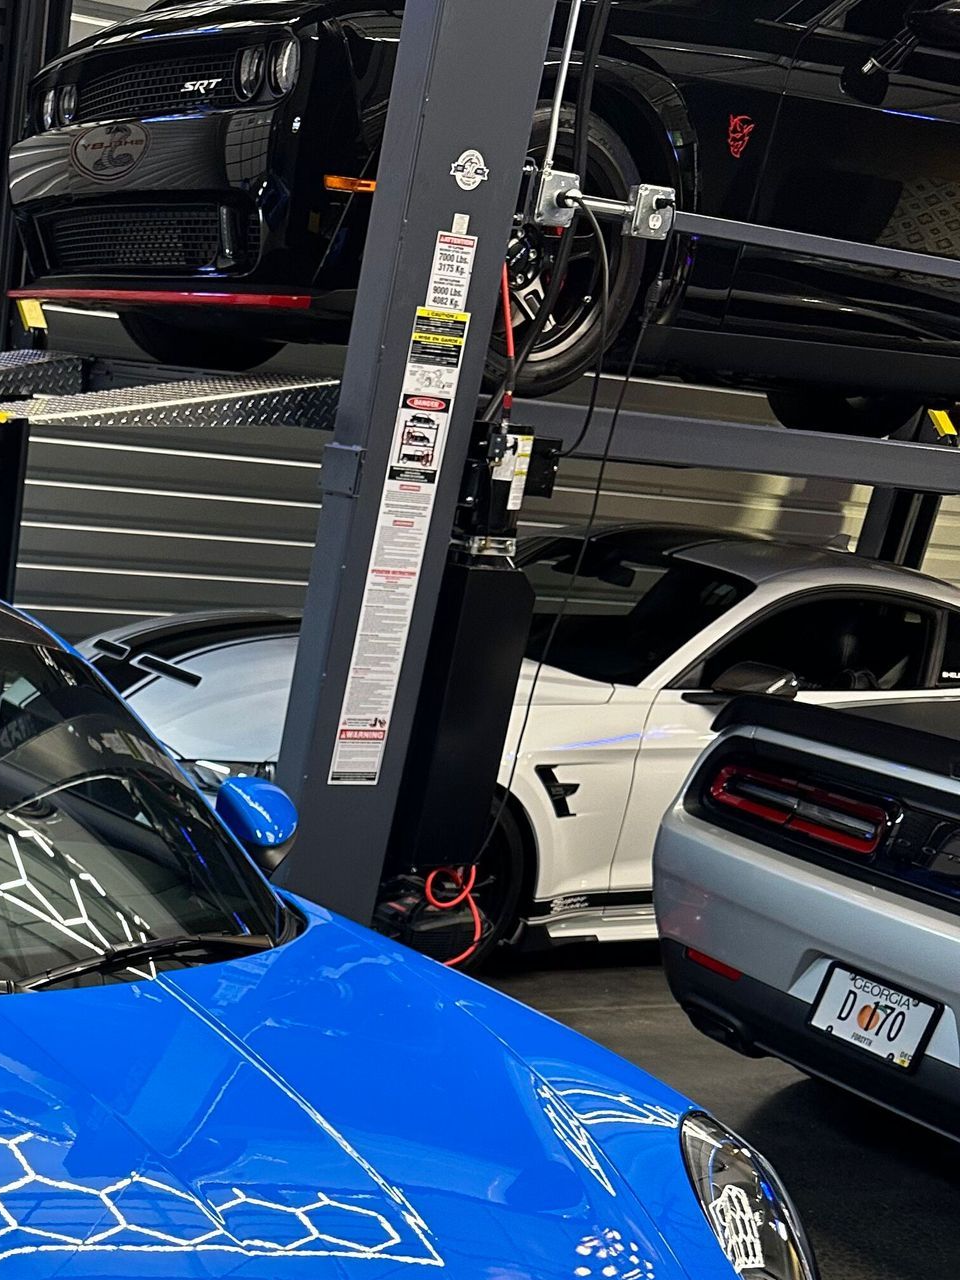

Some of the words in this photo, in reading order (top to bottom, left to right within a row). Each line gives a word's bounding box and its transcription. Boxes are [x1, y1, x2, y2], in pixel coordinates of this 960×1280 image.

[180, 78, 223, 94] SRT
[438, 252, 455, 263] 7000
[437, 262, 455, 273] 3175
[432, 285, 449, 296] 9000
[853, 977, 911, 1011] GEORGIA
[837, 989, 858, 1022] D
